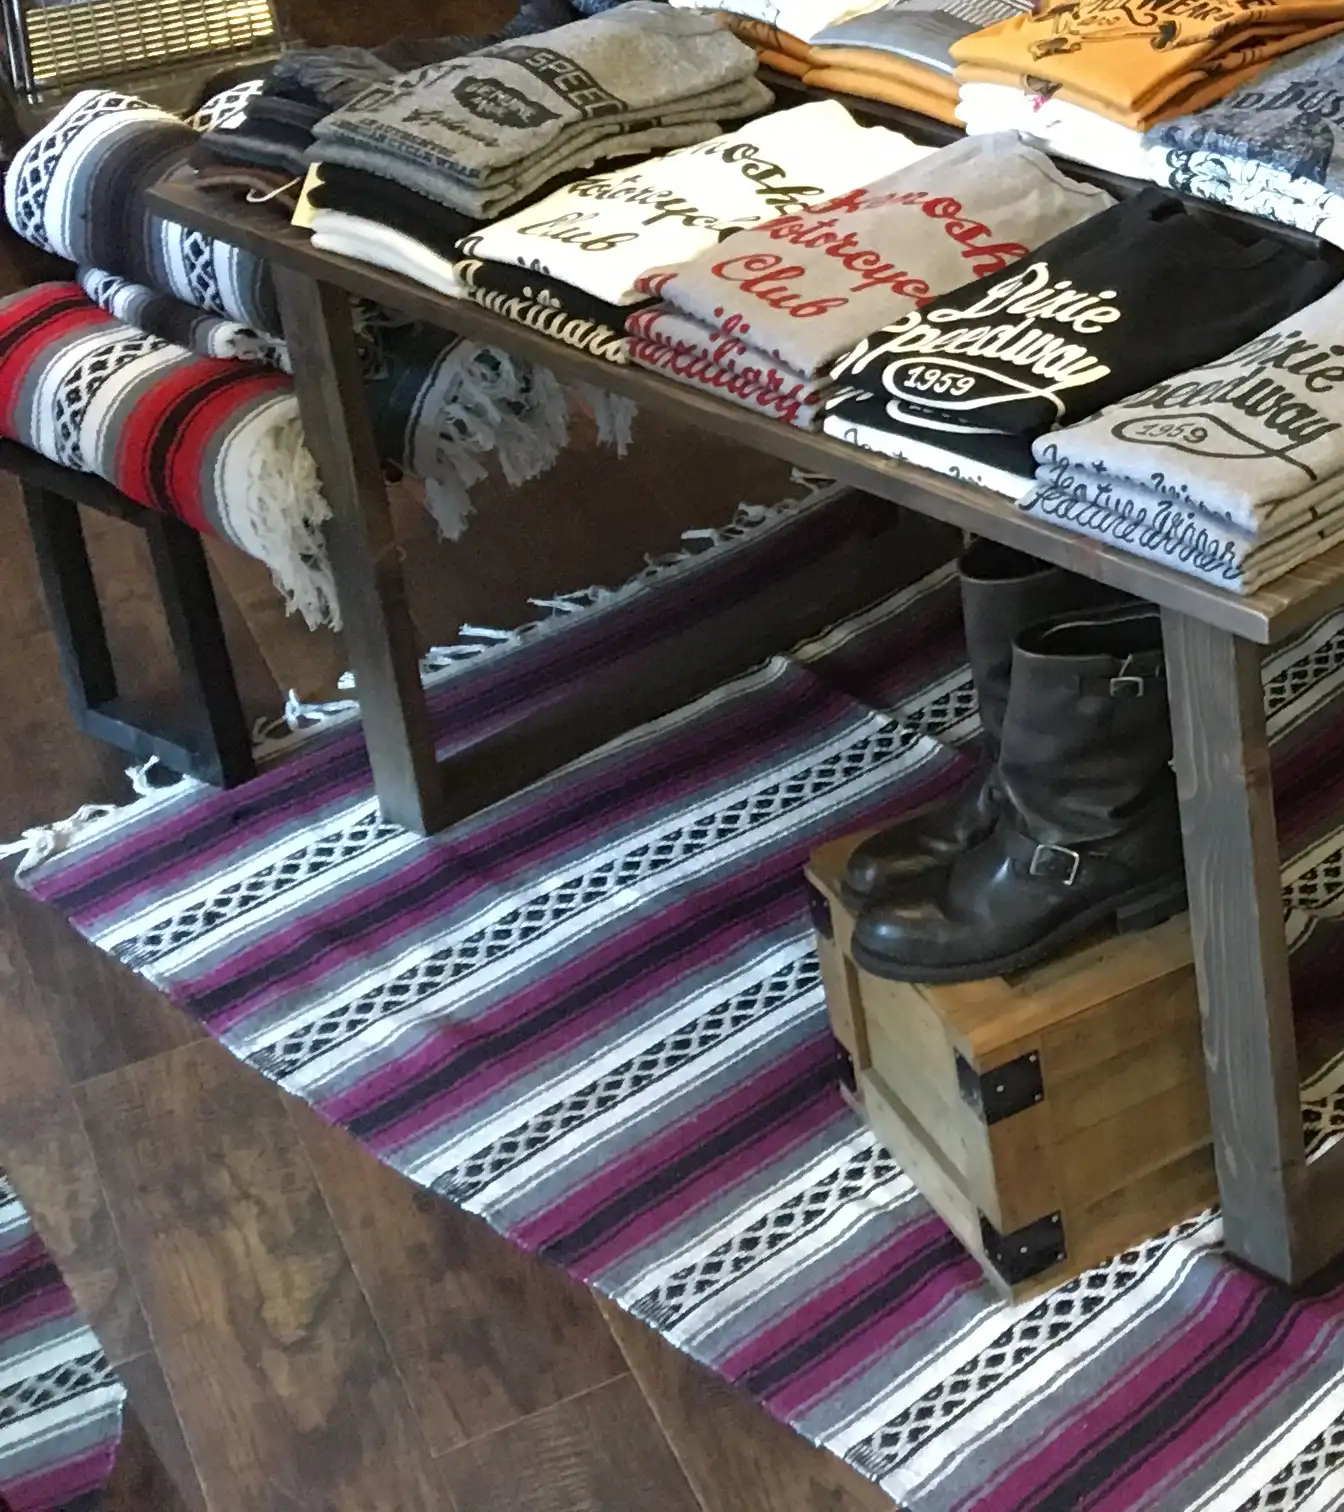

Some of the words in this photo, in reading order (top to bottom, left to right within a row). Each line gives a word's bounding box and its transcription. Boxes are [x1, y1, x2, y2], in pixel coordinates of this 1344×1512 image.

[711, 252, 849, 318] Club
[926, 261, 1121, 334] Dixie
[902, 365, 976, 396] 1959
[1122, 366, 1342, 445] peedway
[1135, 421, 1209, 444] 1959
